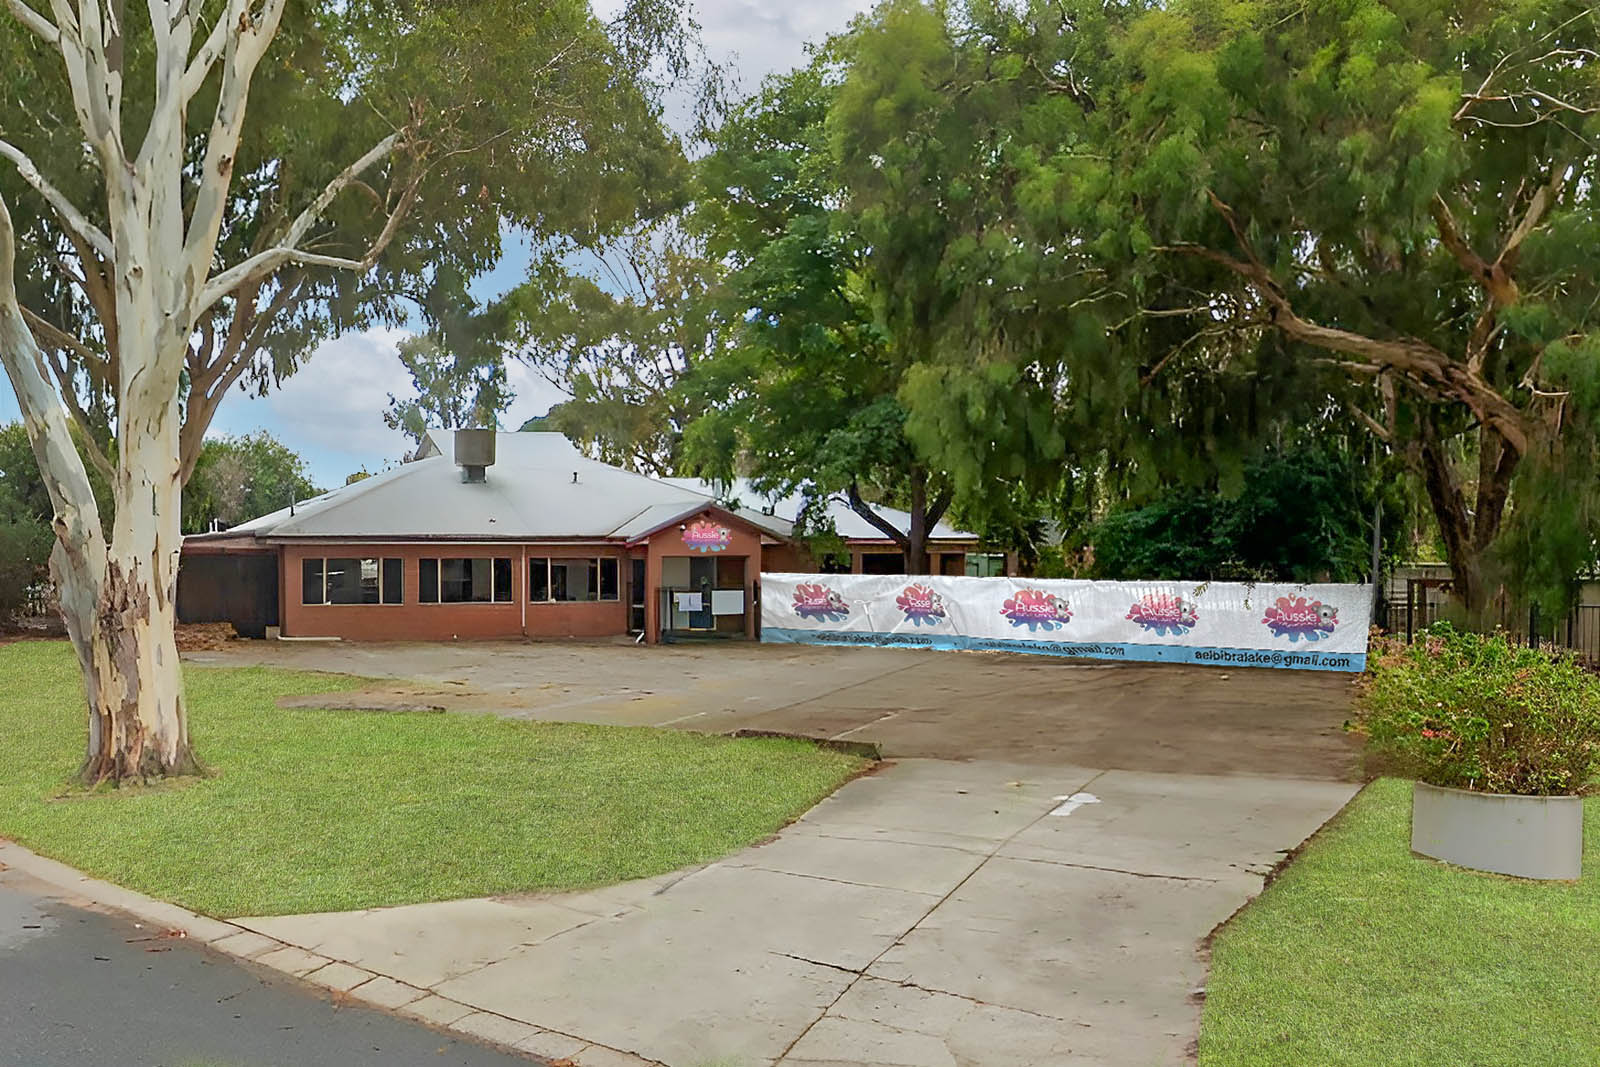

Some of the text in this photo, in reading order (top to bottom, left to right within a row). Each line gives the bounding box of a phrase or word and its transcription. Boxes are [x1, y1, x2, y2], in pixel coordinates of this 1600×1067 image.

[691, 528, 719, 539] Aussie
[1015, 602, 1055, 614] Aussie
[1140, 604, 1180, 617] Aussie
[1276, 609, 1317, 622] Aussie
